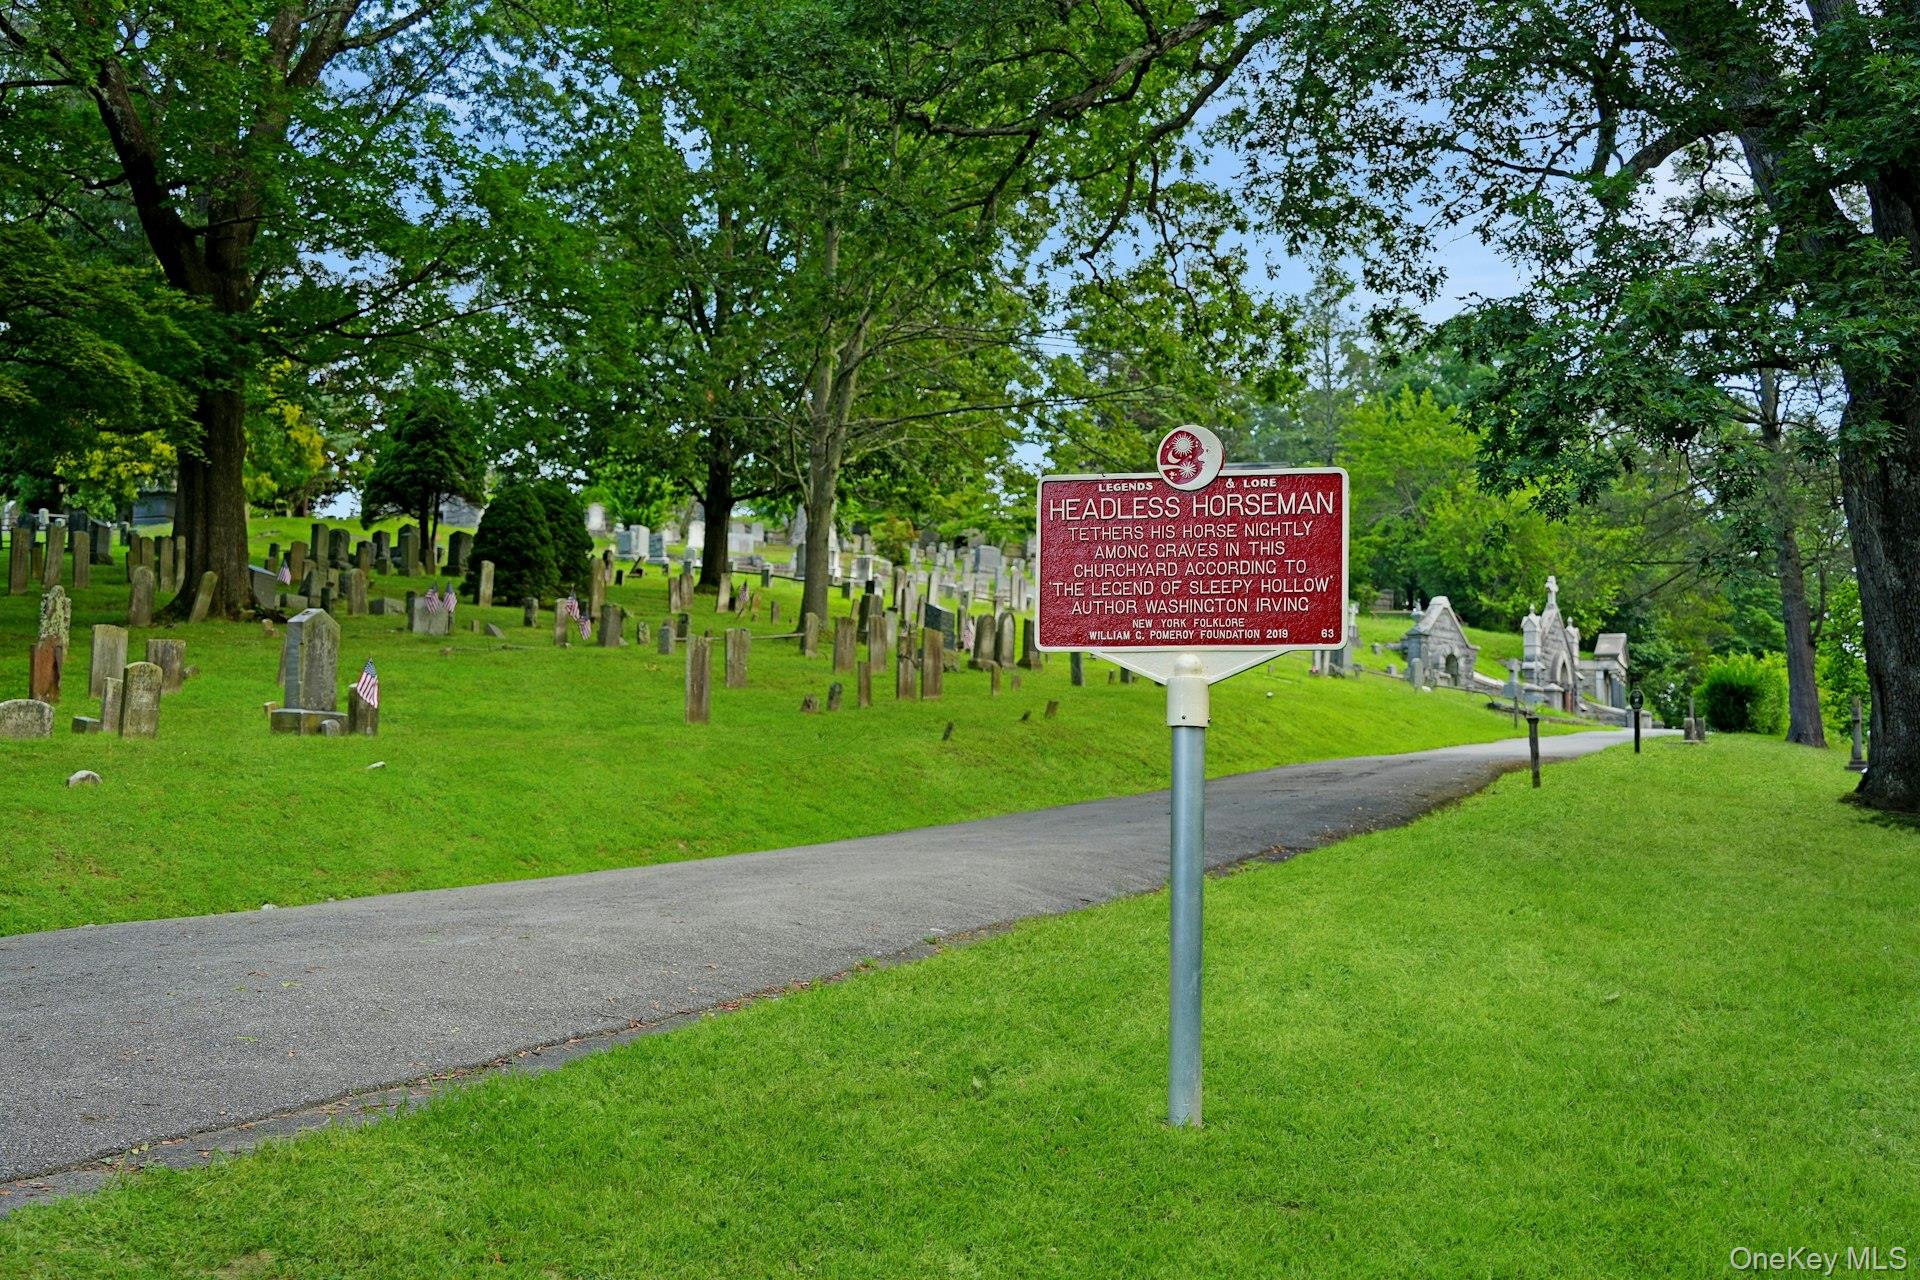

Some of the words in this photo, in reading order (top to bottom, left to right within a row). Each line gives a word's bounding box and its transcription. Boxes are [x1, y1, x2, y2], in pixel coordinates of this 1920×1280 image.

[1099, 483, 1153, 492] LEGENDS
[1226, 478, 1235, 488] &
[1243, 479, 1277, 488] LORE
[1050, 497, 1181, 521] HEADLESS
[1193, 492, 1334, 517] HORSEMAN
[1068, 526, 1144, 541] TETHERS
[1151, 525, 1175, 539] HIS
[1183, 525, 1238, 539] HORSE
[1244, 521, 1313, 537] NIGHTLY
[1095, 545, 1148, 559] AMONG
[1155, 543, 1218, 558] GRAVES
[1225, 542, 1239, 556] IN
[1248, 542, 1285, 556] THIS
[1074, 562, 1178, 578] CHURCHYARD
[1185, 561, 1276, 576] ACCORDING
[1284, 560, 1307, 574] TO
[1092, 581, 1154, 596] LEGEND
[1161, 581, 1182, 595] OF
[1189, 580, 1253, 594] SLEEPY
[1071, 601, 1137, 615] AUTHOR
[1145, 599, 1248, 614] WASHINGTON
[1256, 597, 1309, 612] IRVING
[1133, 620, 1152, 628] NEW
[1161, 619, 1186, 628] YORK
[1194, 618, 1244, 627] FOLKLORE
[1089, 631, 1130, 640] WILLIAM
[1150, 630, 1194, 639] POMEROY
[1200, 630, 1260, 639] FOUNDATION
[1321, 629, 1334, 638] 63
